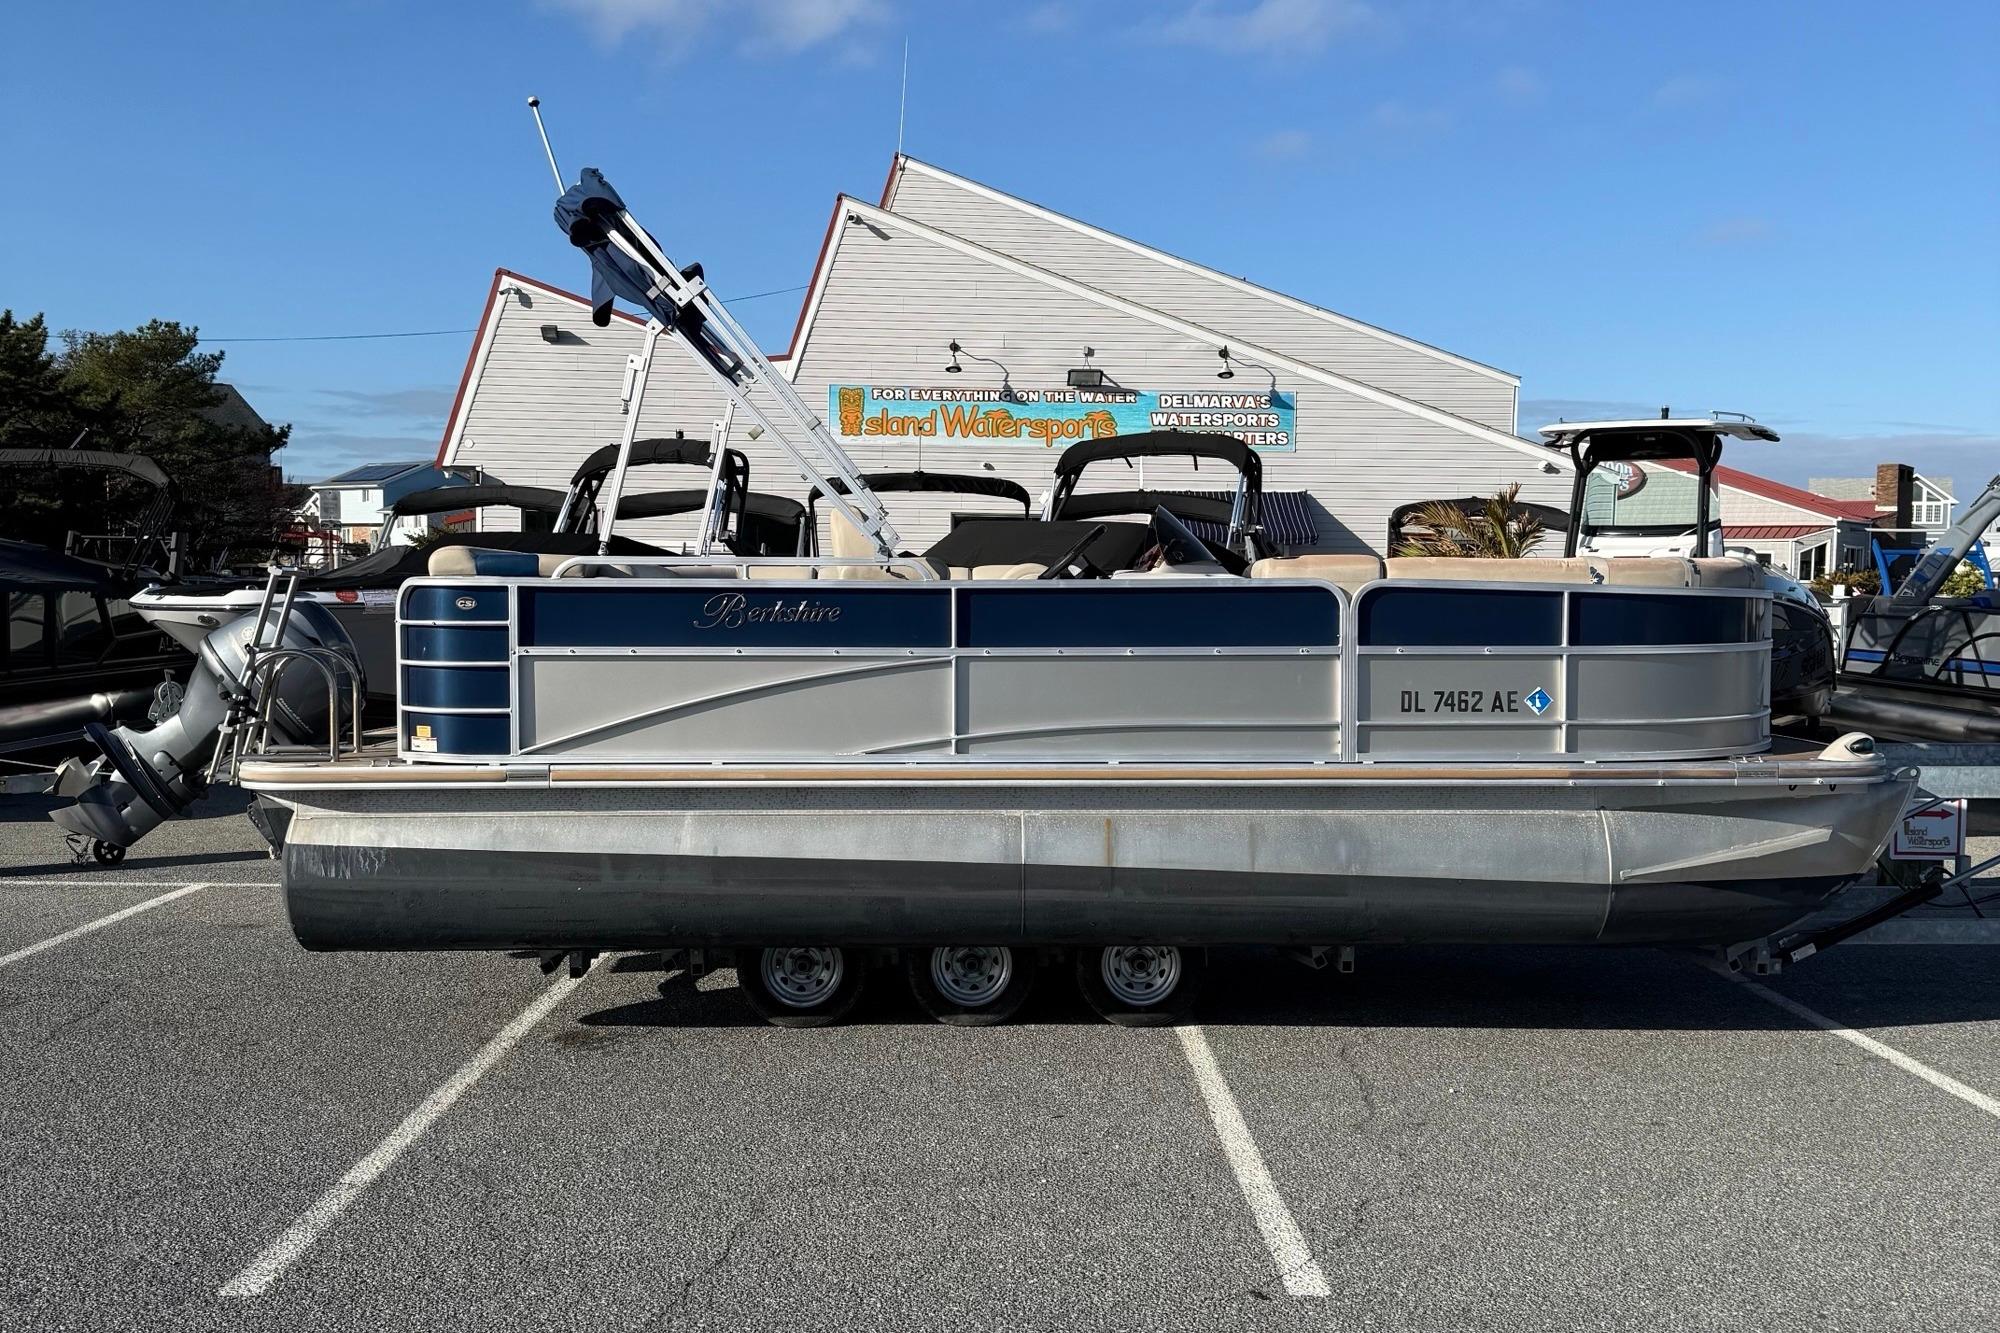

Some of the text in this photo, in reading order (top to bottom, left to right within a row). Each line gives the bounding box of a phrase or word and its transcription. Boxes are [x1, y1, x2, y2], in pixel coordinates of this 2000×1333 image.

[871, 388, 1137, 403] FOR EVERYTHING ON THE WATER
[1160, 394, 1271, 409] DELMARVA'S
[1151, 412, 1280, 427] WATERSPORTS
[693, 592, 842, 629] Berkshire
[1401, 691, 1519, 713] DL 7462 AE
